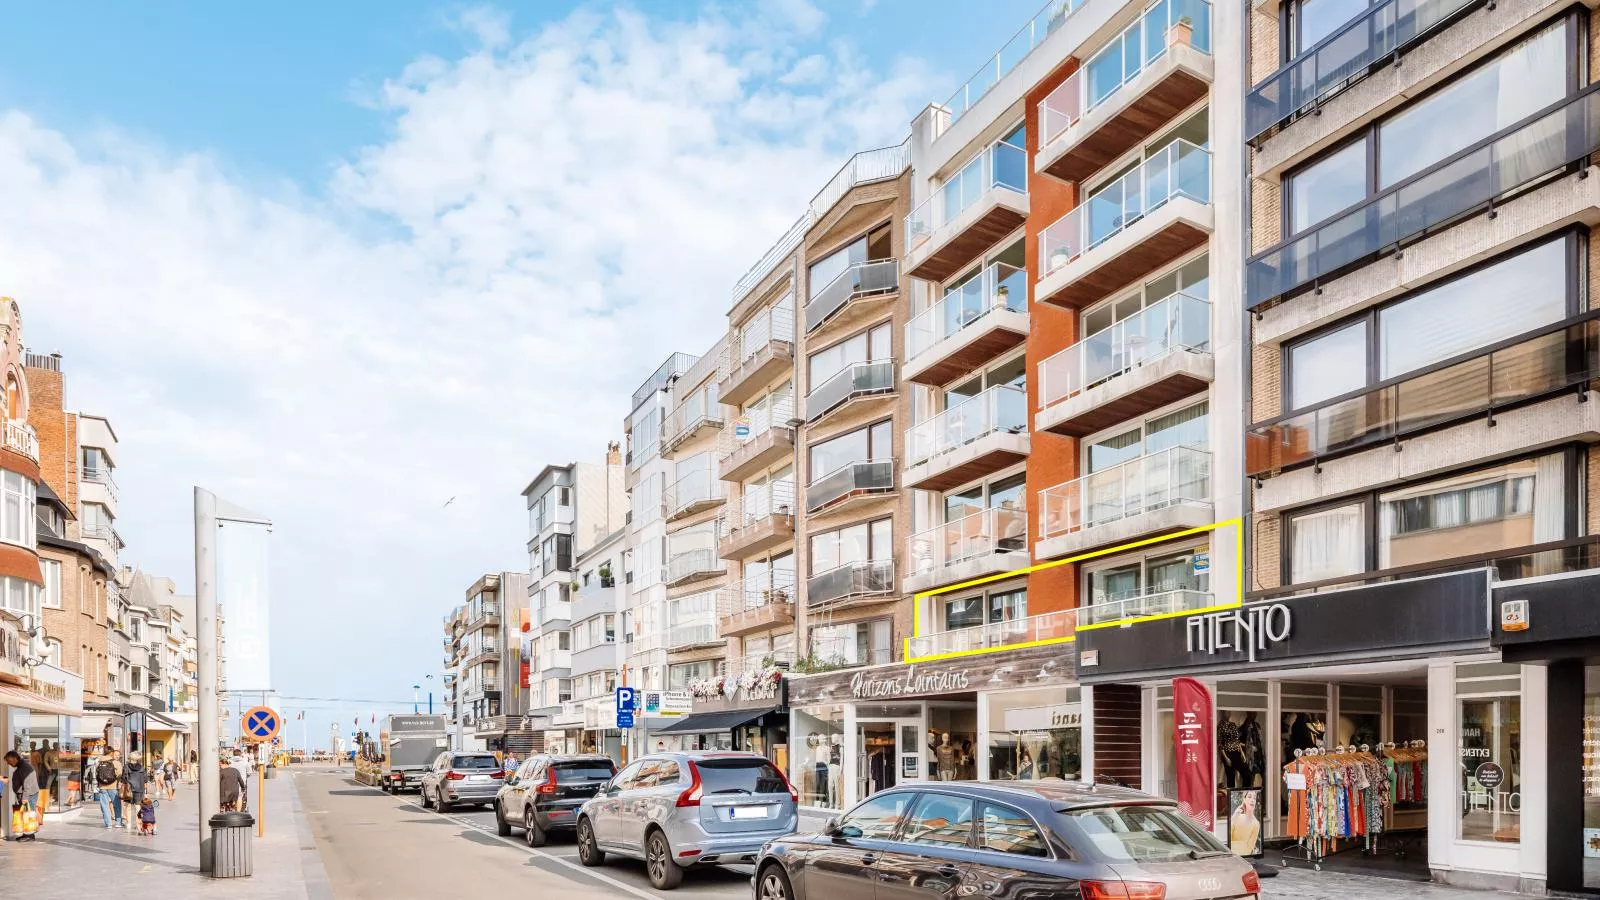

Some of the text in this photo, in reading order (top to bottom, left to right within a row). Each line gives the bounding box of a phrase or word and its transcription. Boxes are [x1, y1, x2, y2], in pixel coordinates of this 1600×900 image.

[1187, 604, 1291, 662] ATENTO
[850, 664, 969, 698] Horizons Lointains
[620, 690, 631, 708] P
